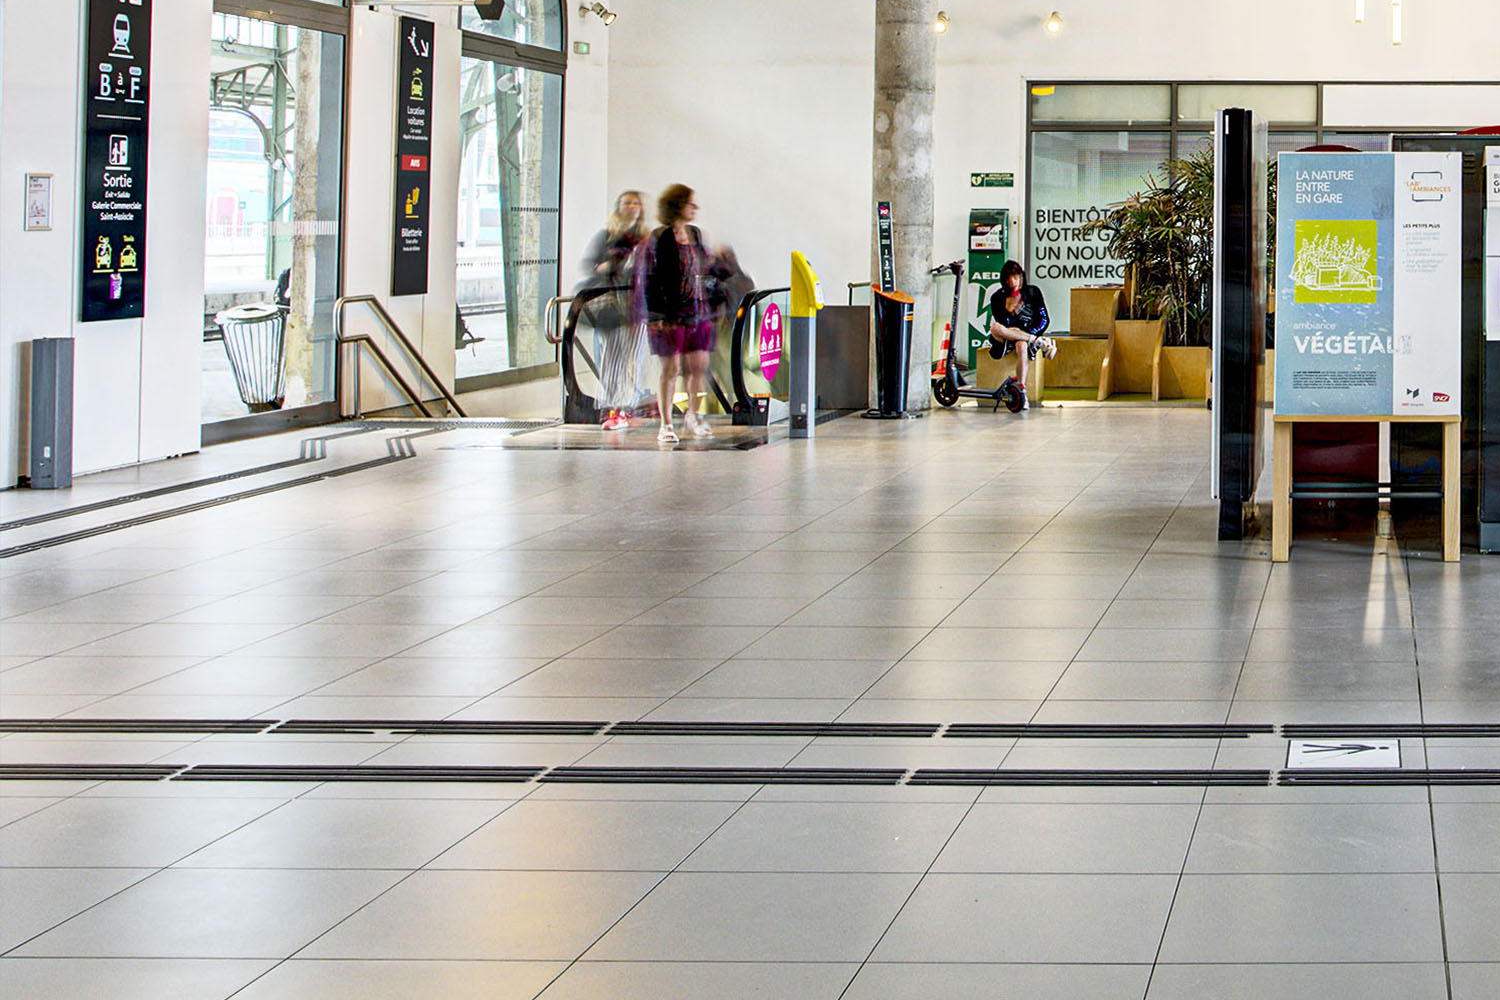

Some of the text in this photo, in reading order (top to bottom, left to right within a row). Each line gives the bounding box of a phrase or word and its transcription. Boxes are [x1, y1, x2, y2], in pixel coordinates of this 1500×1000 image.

[100, 73, 111, 96] B
[130, 77, 141, 99] F
[407, 105, 425, 115] Location
[103, 172, 132, 188] Sortie
[1296, 170, 1354, 180] LA NATURE
[1296, 182, 1330, 191] ENTRE
[1296, 193, 1343, 203] EN GARE
[1036, 206, 1111, 223] BIENTÔT
[1036, 246, 1118, 261] UN NOUV
[972, 272, 1000, 280] AED
[1035, 265, 1124, 279] COMMERC
[1293, 322, 1336, 330] ambiance
[971, 340, 993, 348] DA
